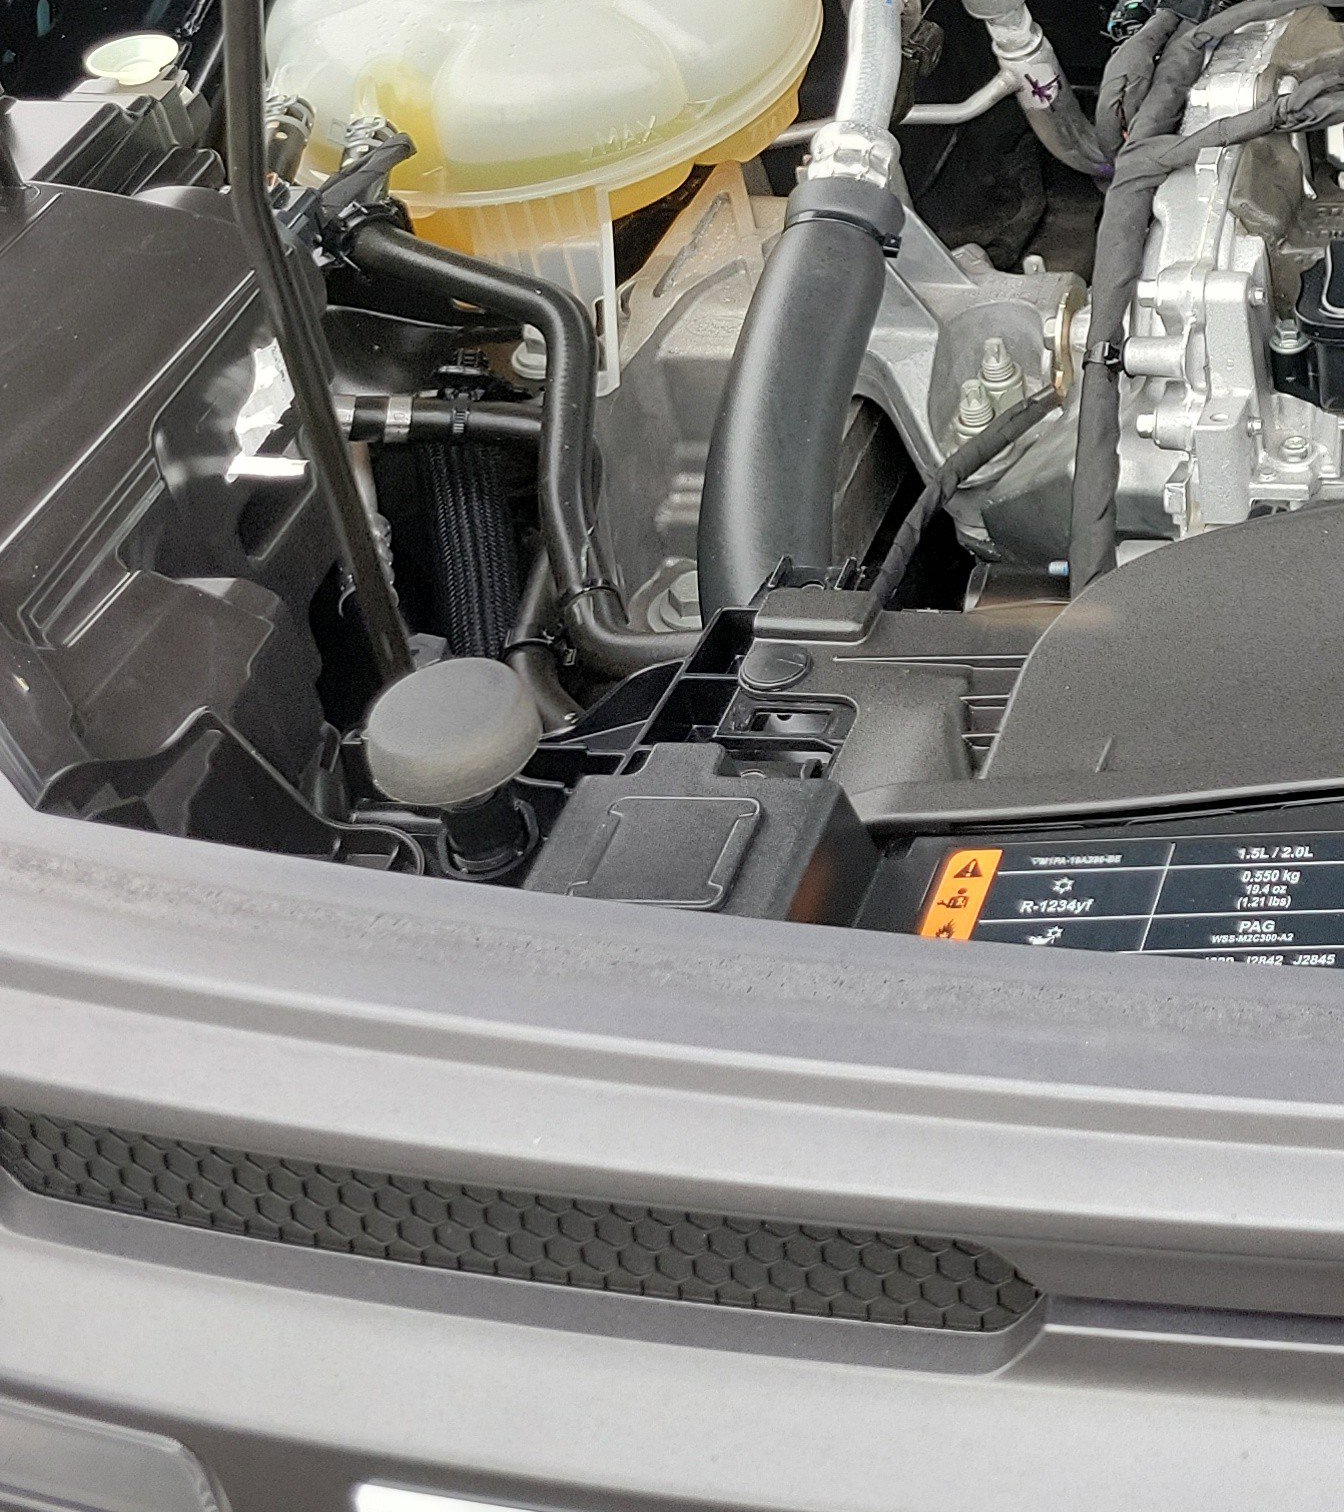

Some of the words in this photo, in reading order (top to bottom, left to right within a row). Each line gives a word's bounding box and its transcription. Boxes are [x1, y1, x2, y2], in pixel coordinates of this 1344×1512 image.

[1238, 847, 1270, 859] 1.5L
[1281, 846, 1314, 858] 2.0L
[1242, 870, 1280, 883] 0.550
[1282, 869, 1301, 884] kg
[1246, 884, 1270, 895] 19.4
[1272, 885, 1287, 894] oz
[1019, 899, 1095, 914] R-1234yf
[1237, 896, 1266, 910] (1.21
[1268, 895, 1292, 908] lbs)
[1239, 919, 1276, 933] PAG
[1292, 954, 1336, 966] J2845
